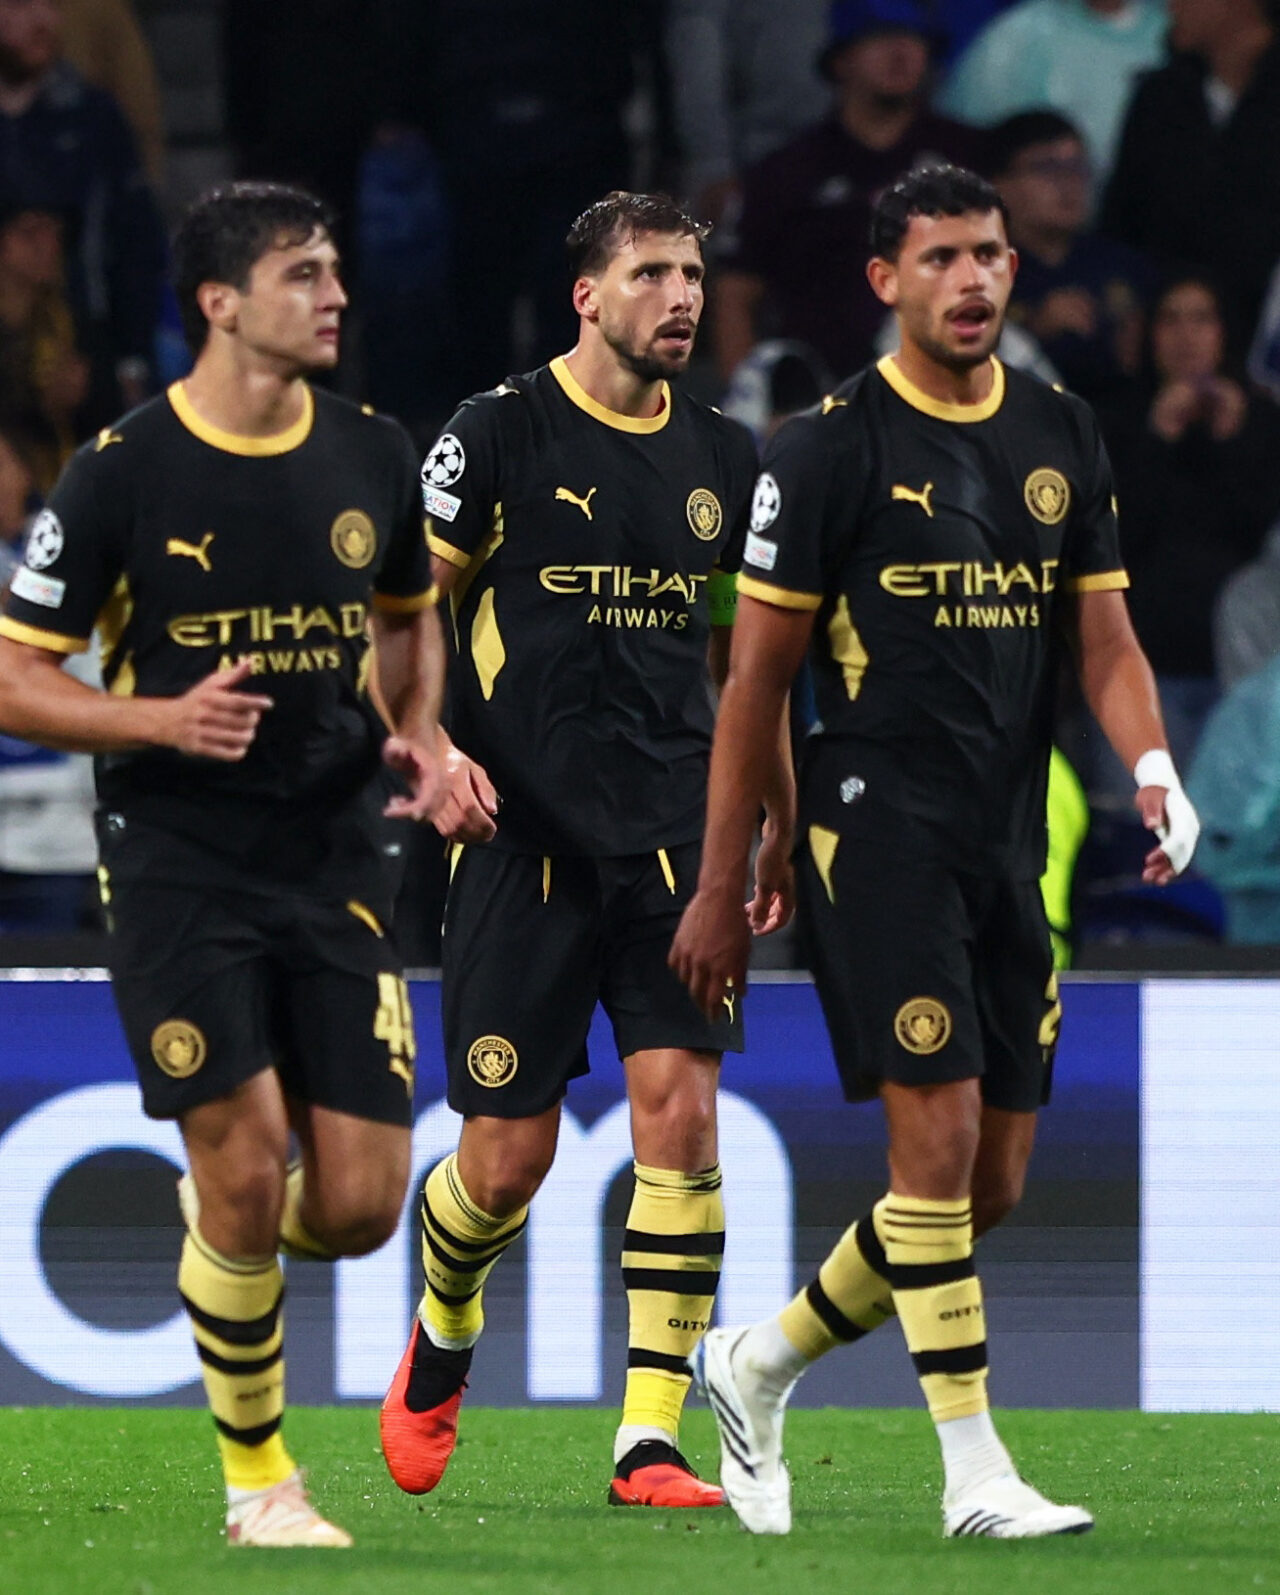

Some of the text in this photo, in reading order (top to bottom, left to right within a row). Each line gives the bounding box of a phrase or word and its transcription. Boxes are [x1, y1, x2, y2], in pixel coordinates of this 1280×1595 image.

[168, 602, 366, 647] ETIHAD
[587, 604, 689, 630] AIRWAYS
[934, 604, 1040, 628] AIRWAYS
